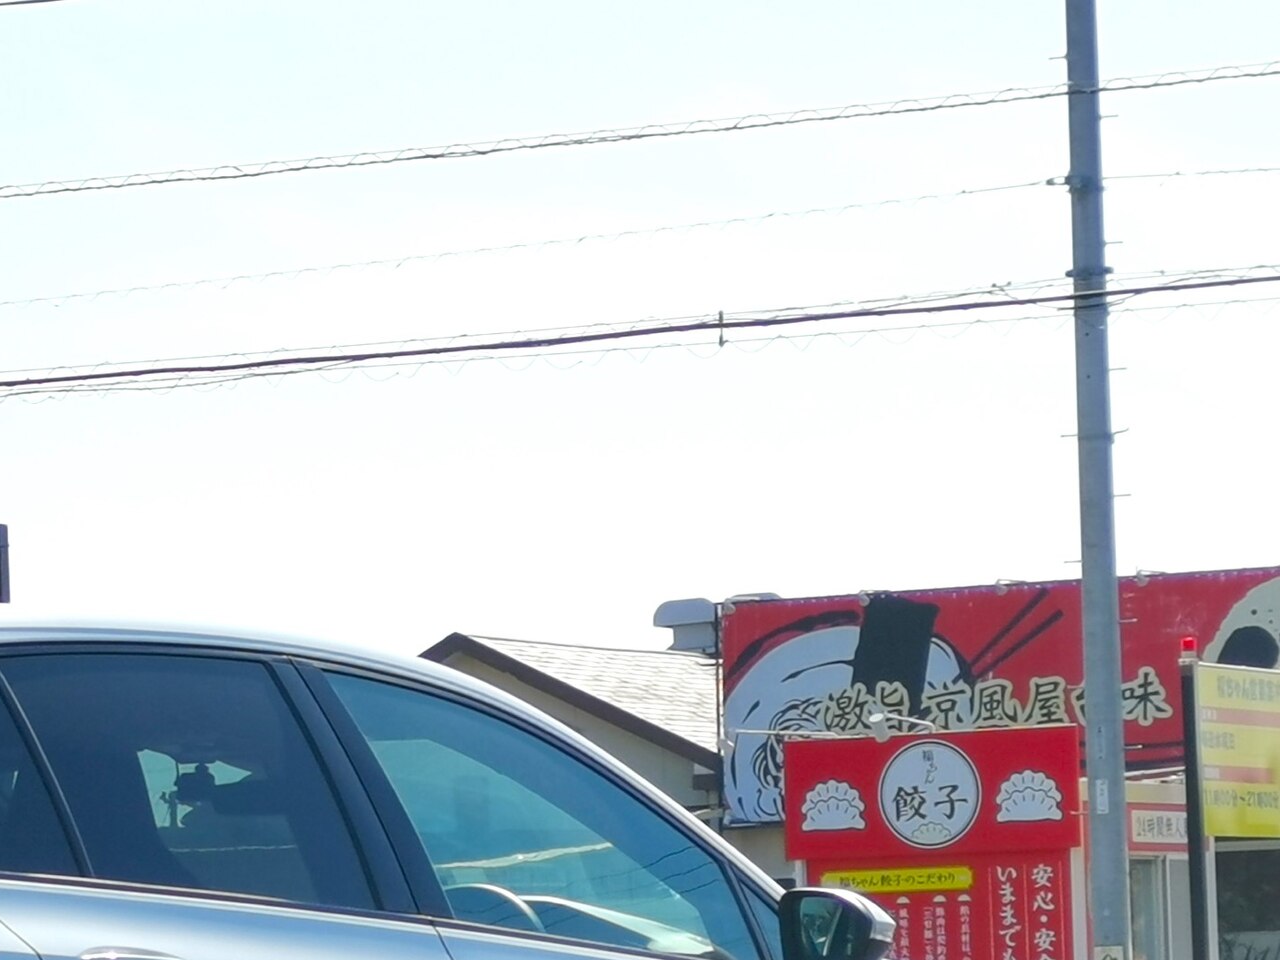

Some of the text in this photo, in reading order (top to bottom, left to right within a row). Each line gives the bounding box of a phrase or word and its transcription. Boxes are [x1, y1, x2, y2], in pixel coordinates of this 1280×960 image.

[823, 669, 1170, 733] 激旨京風屋味
[892, 784, 969, 822] 餃子
